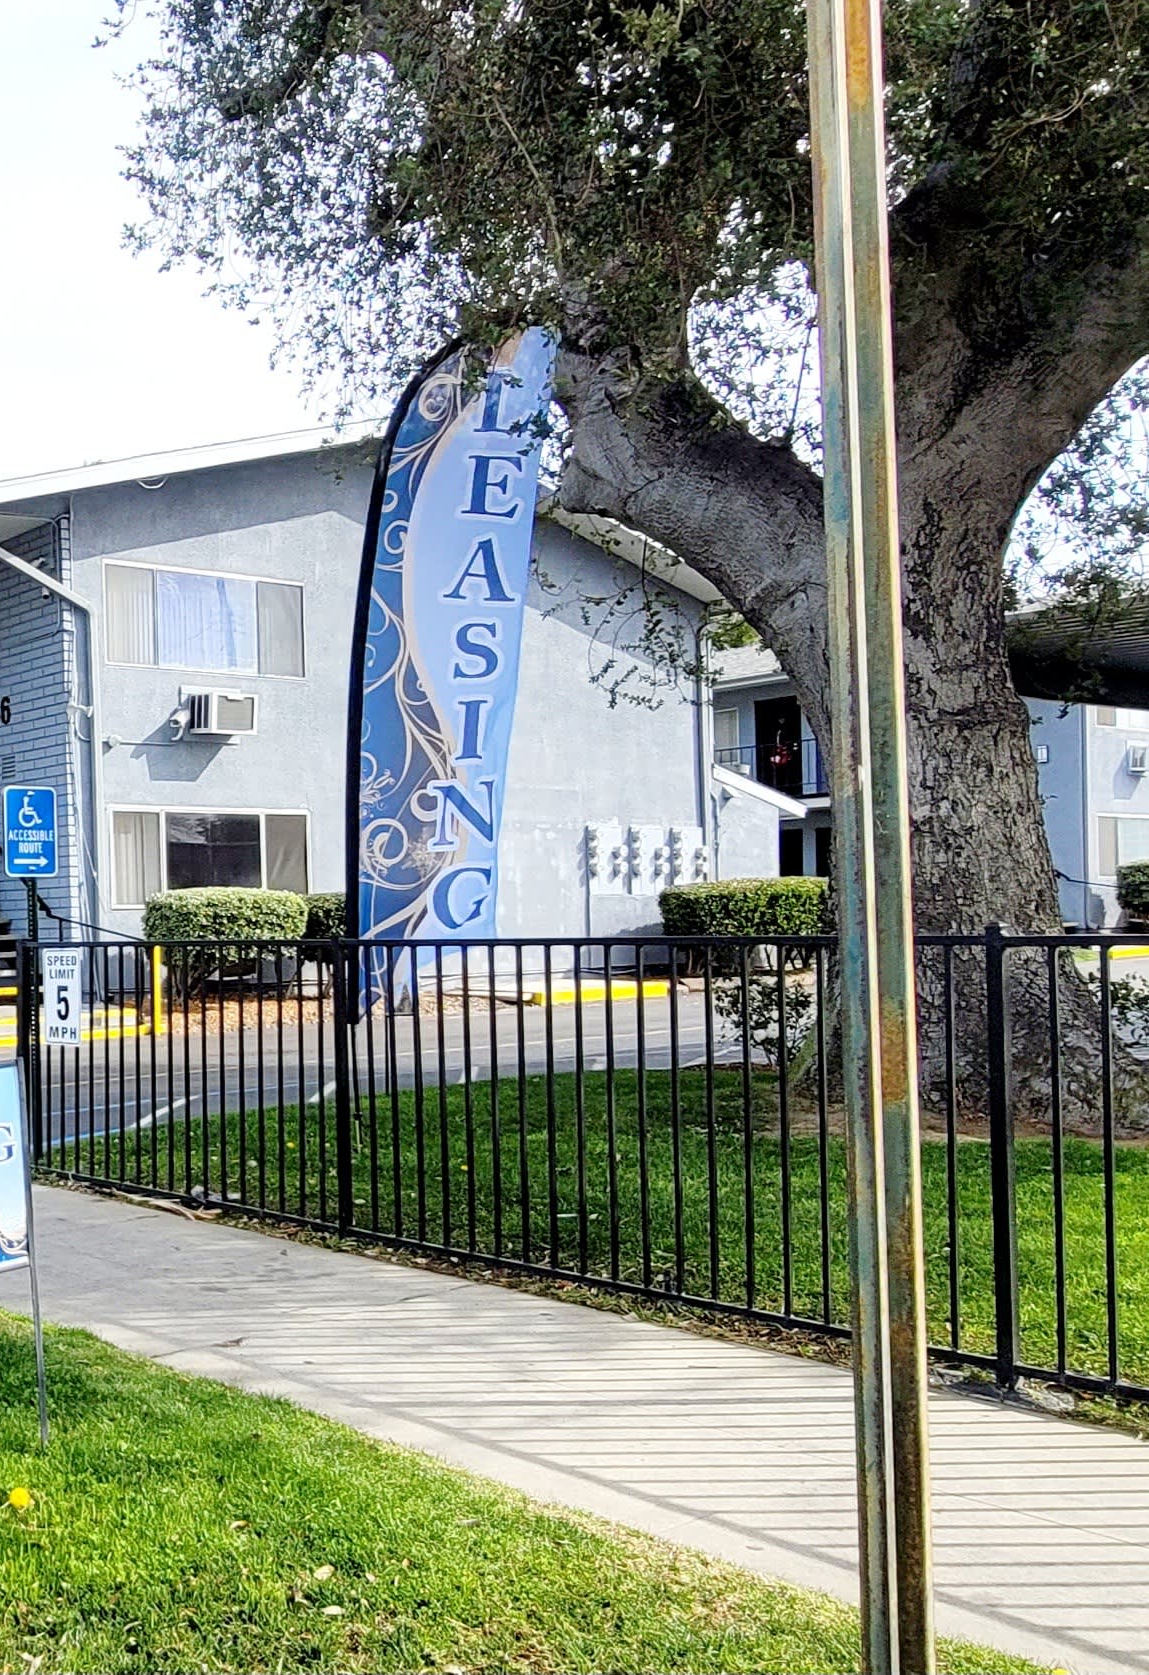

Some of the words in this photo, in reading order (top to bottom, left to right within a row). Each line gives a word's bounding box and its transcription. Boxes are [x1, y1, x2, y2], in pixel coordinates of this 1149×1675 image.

[432, 372, 532, 930] LEASING
[8, 829, 54, 842] ACCESSIBLE
[18, 842, 43, 854] ROUTE
[46, 955, 77, 967] SPEED
[49, 968, 75, 980] LIMIT
[56, 985, 70, 1021] 5
[49, 1026, 77, 1040] MPH
